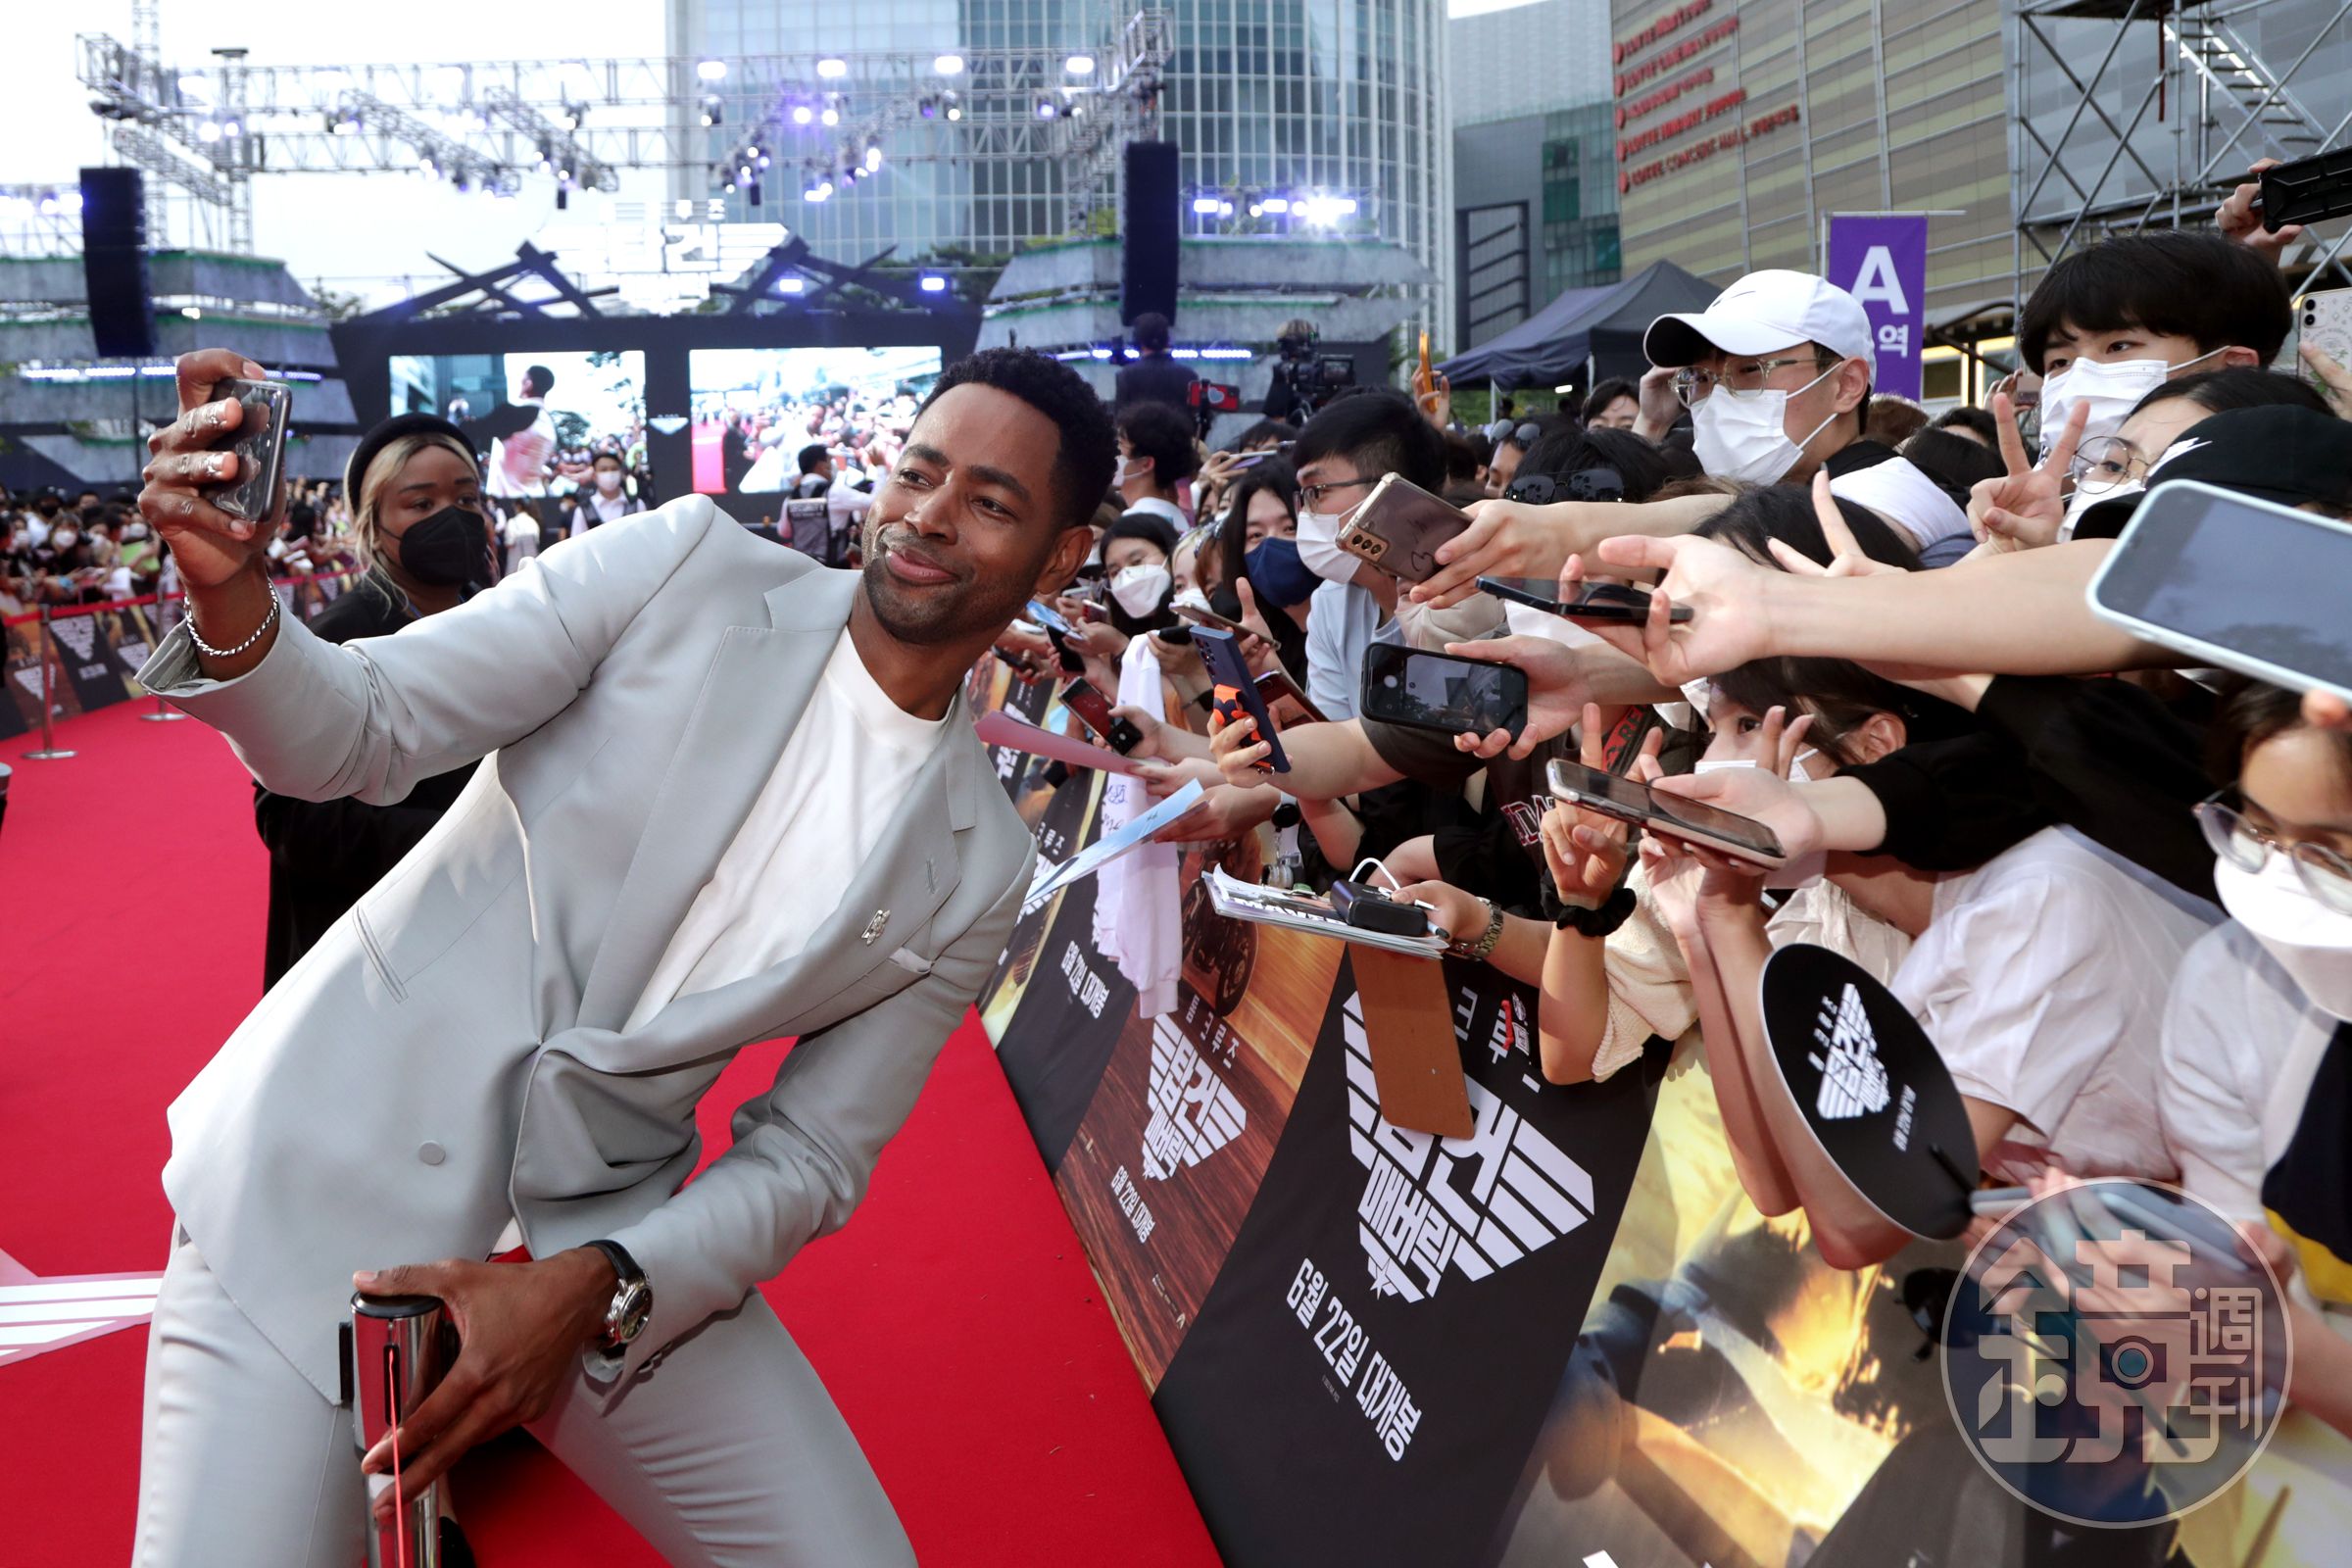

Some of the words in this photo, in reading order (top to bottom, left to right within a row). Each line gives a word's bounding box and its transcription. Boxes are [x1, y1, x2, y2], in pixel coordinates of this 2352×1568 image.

[1850, 246, 1909, 314] A
[1879, 324, 1909, 358] 역
[1200, 1011, 1240, 1069] 크루즈
[1111, 1165, 1129, 1196] 6월
[1118, 1181, 1141, 1218] 22일
[1131, 1201, 1155, 1244] 대개봉
[1357, 1152, 1461, 1298] 매버릭
[1287, 1257, 1329, 1330] 6월
[1313, 1296, 1370, 1388] 22일
[1356, 1350, 1422, 1461] 대개봉
